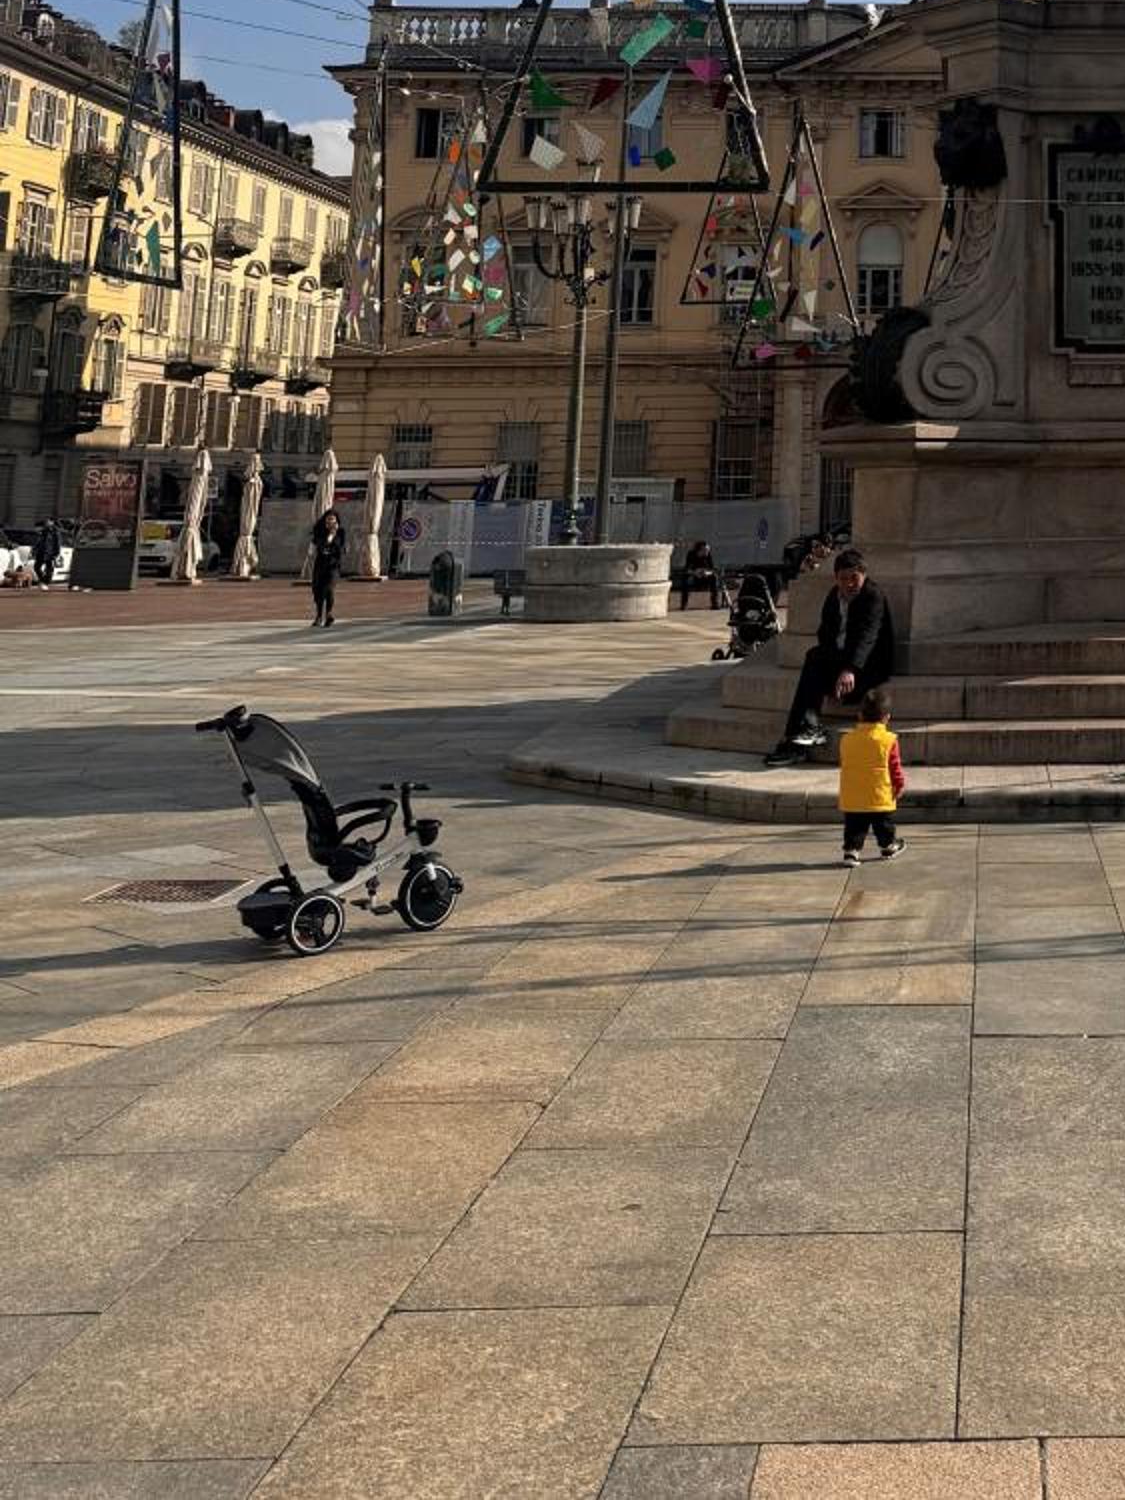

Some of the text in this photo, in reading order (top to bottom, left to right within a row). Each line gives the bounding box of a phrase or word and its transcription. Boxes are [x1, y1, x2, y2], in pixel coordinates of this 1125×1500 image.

[1089, 214, 1124, 229] 1848
[1088, 238, 1125, 252] 1849
[87, 469, 137, 489] Salvo
